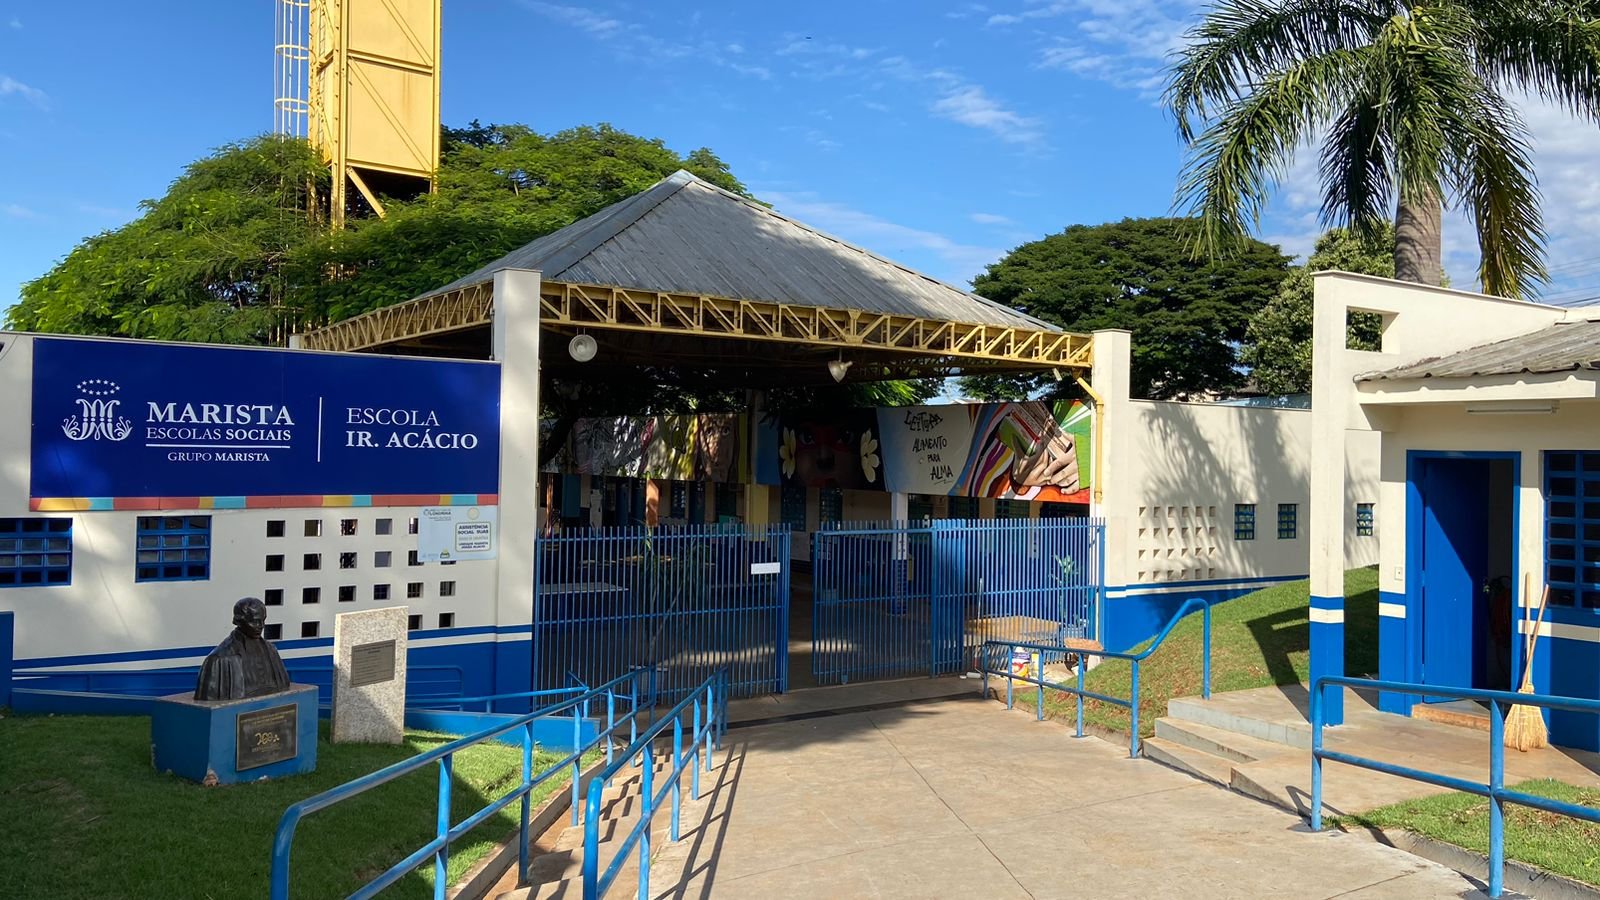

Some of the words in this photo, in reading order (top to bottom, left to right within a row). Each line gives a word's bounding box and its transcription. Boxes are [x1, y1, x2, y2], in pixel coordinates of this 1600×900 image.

[146, 401, 295, 426] MARISTA
[346, 407, 440, 427] ESCOLA
[146, 427, 222, 440] ESCOLAS
[225, 429, 291, 441] SOCIAIS
[345, 430, 379, 448] IR.
[385, 428, 478, 450] ACÁCIO
[167, 452, 212, 462] GRUPO
[214, 452, 270, 462] MARISTA
[927, 453, 941, 463] PARA
[930, 465, 954, 481] ALMA
